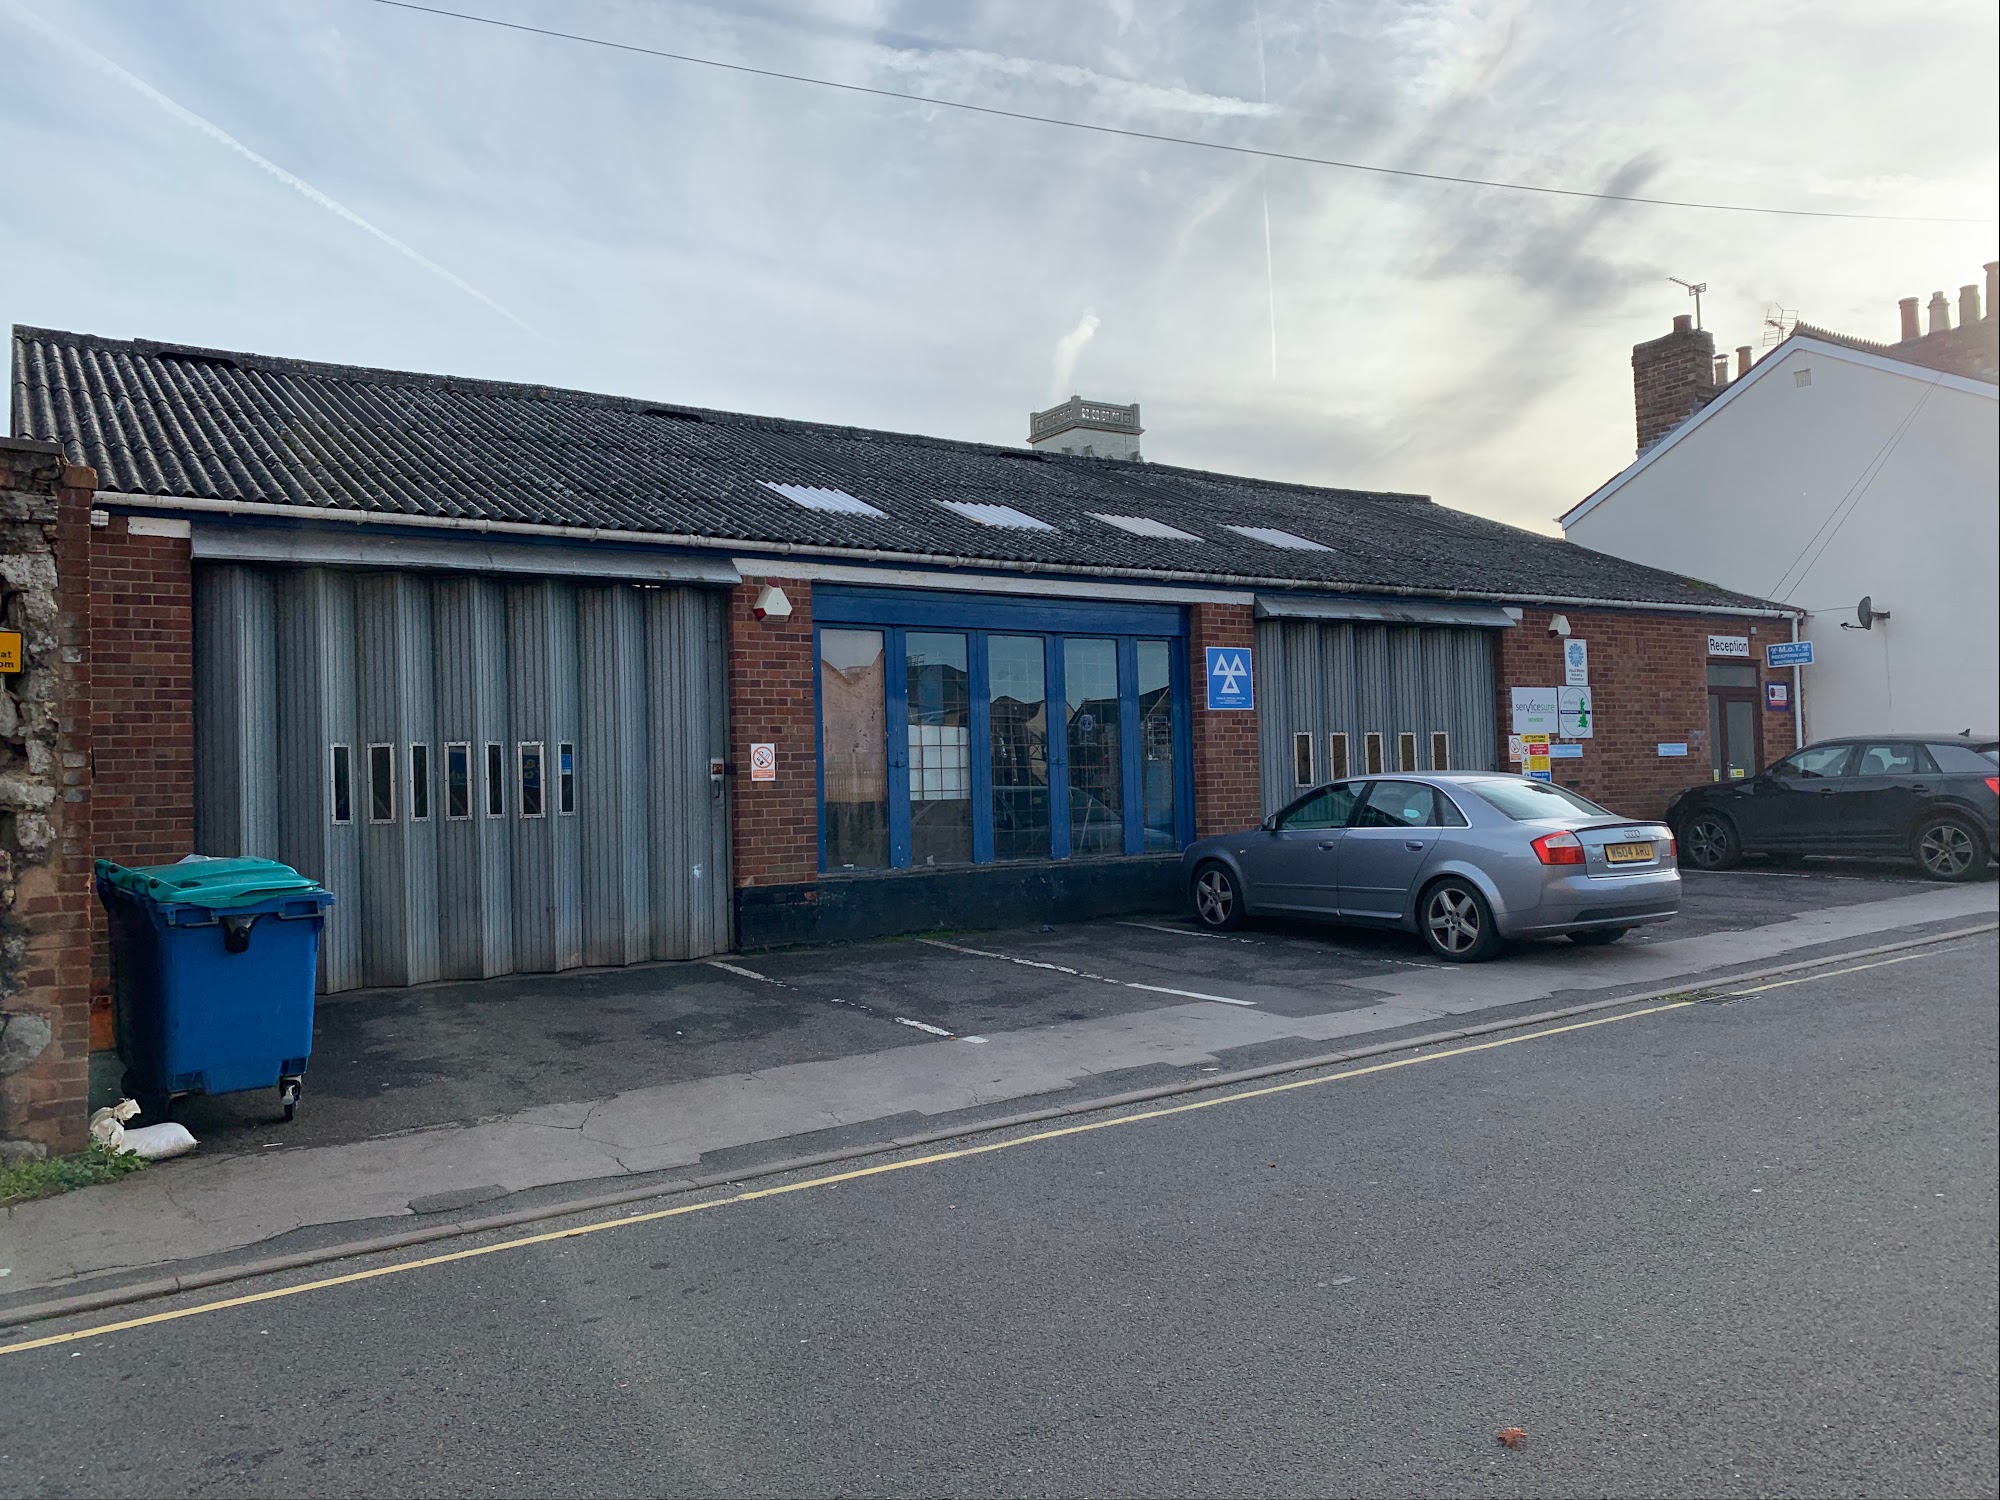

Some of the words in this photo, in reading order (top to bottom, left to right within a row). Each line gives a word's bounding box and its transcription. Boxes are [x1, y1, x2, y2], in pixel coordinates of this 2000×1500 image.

[1709, 638, 1748, 653] Reception
[1778, 644, 1801, 653] M.o.T.
[1635, 845, 1650, 857] ARU
